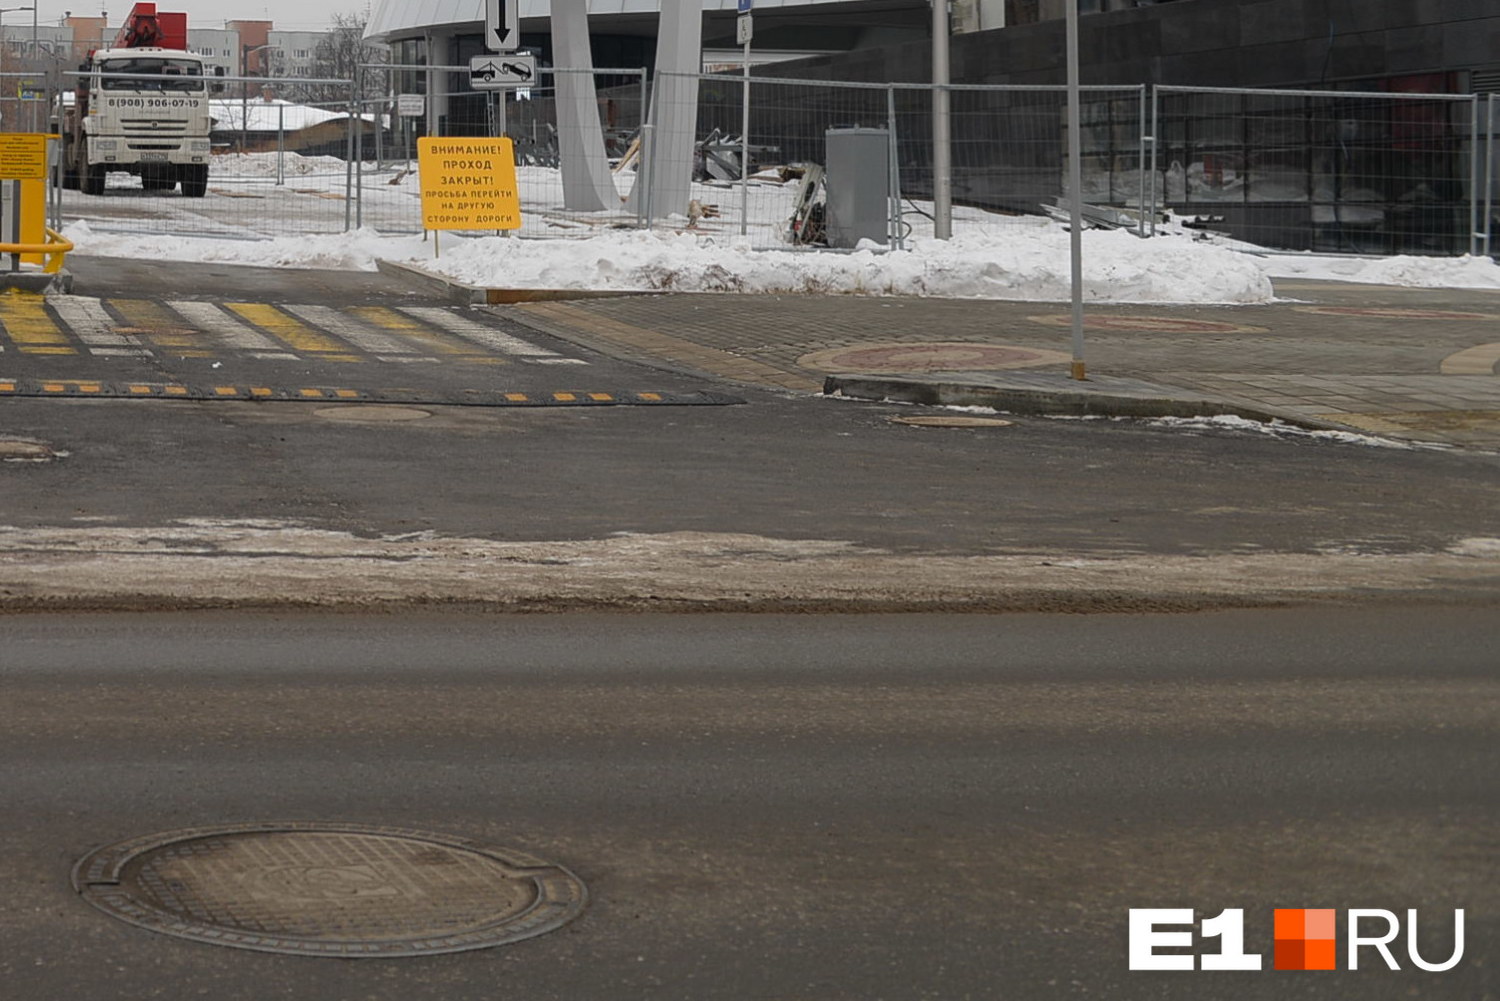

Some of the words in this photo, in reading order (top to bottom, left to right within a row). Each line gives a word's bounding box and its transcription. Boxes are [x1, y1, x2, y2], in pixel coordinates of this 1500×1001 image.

[108, 98, 145, 109] 8(908)
[147, 99, 199, 108] 906-07-19
[431, 145, 501, 155] ВНИМАНИЕ!
[443, 160, 493, 170] ПРОХОД
[441, 176, 494, 186] ЗАКРЫТ!
[471, 190, 512, 198] ПЕРЕЙТИ
[457, 202, 495, 210] ДРУГУЮ
[427, 215, 469, 223] СТОРОНУ
[476, 215, 512, 223] ДОРОГИ
